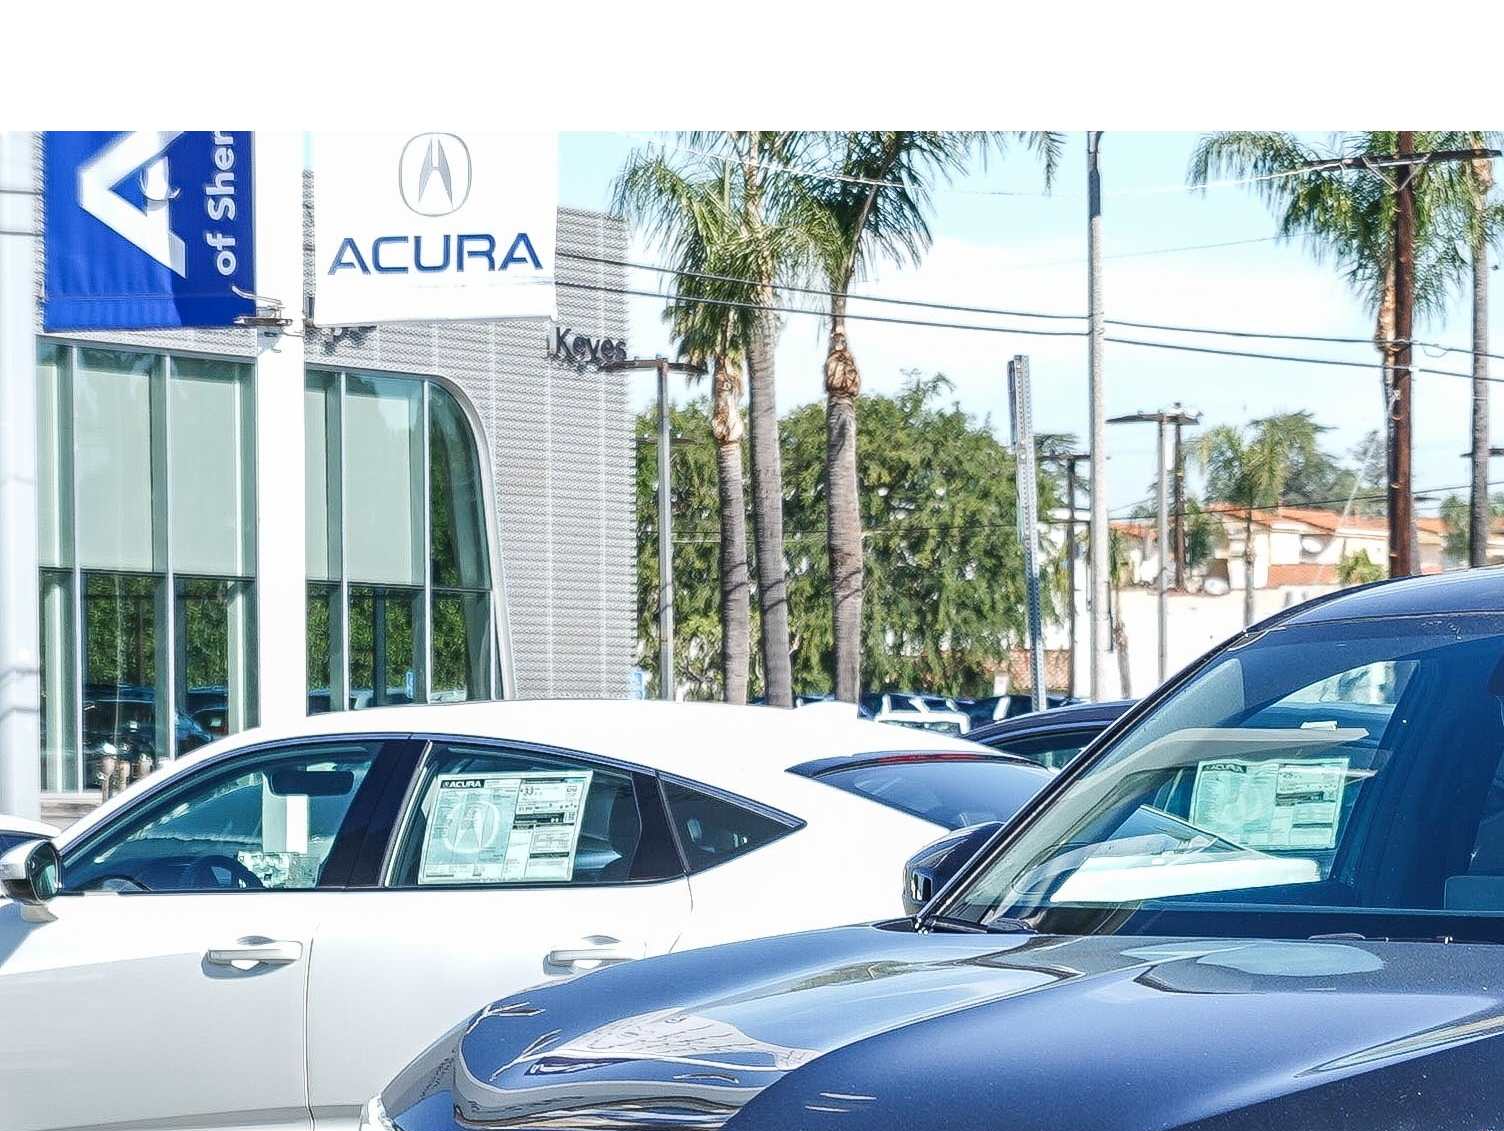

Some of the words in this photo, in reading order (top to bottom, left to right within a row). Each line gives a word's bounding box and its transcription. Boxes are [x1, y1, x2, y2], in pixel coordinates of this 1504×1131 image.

[206, 232, 237, 276] of
[328, 233, 543, 275] ACURA
[556, 327, 626, 361] Keyes
[449, 780, 482, 788] ACURA
